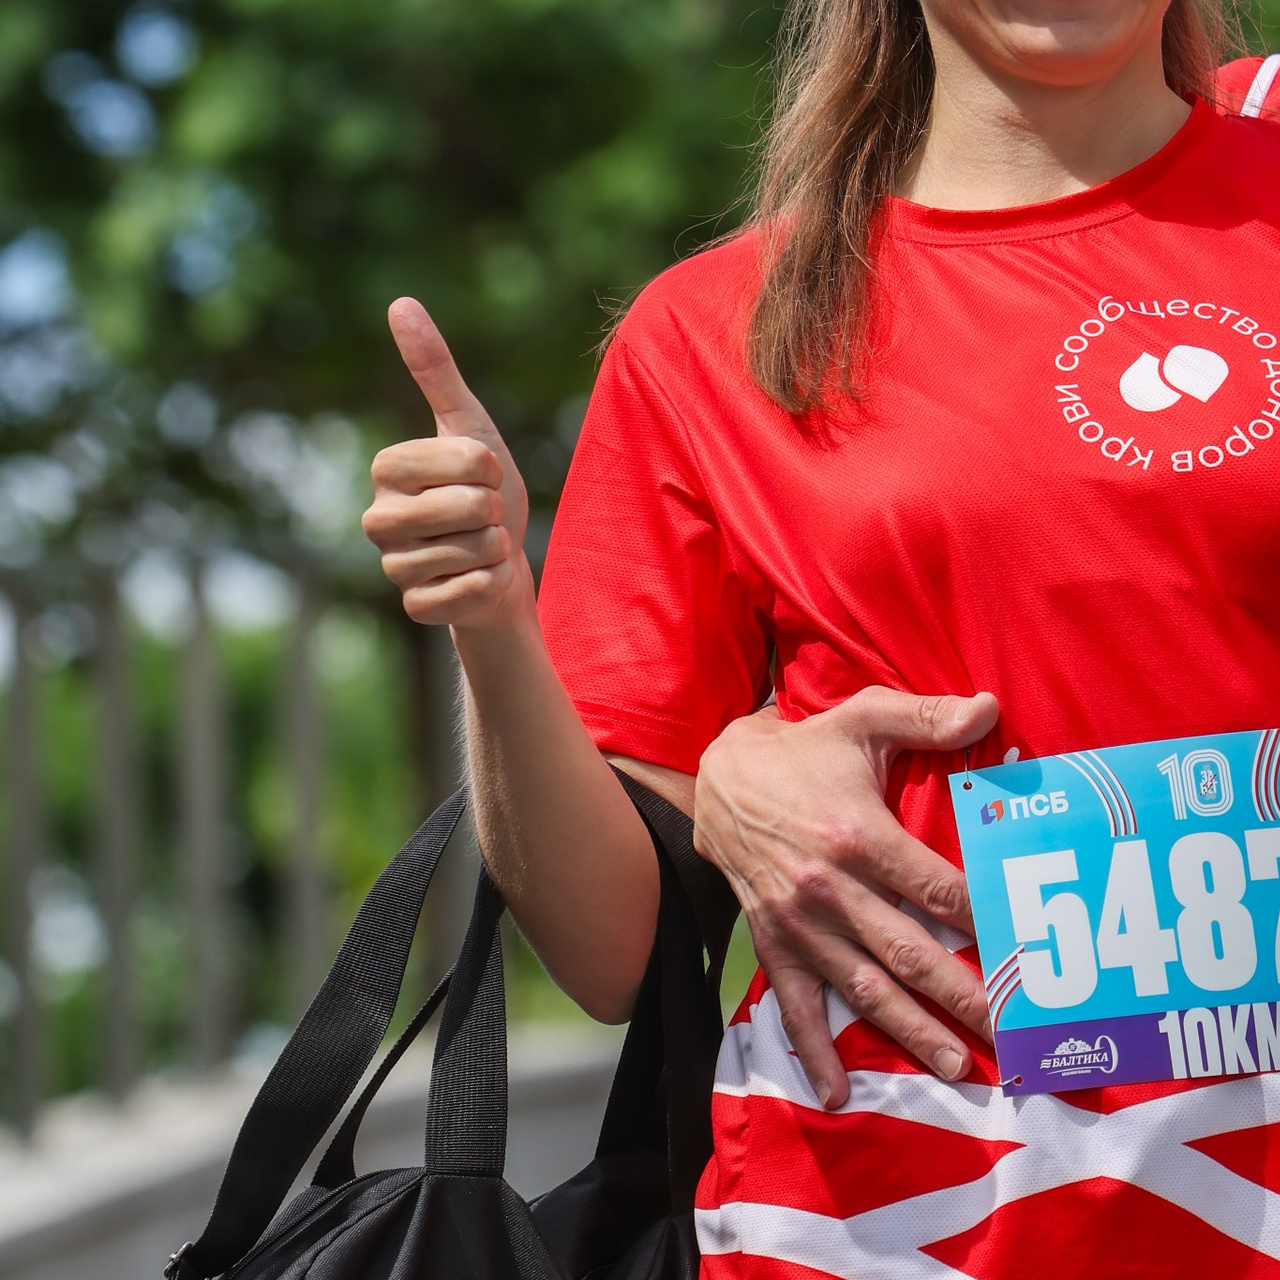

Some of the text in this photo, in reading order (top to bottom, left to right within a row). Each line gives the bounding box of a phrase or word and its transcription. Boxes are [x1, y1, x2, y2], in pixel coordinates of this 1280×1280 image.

[1054, 295, 1278, 372] сообщество
[1054, 383, 1154, 470] крови
[1009, 789, 1070, 820] ПСБ
[1156, 748, 1235, 821] 10
[1051, 1052, 1109, 1068] БАЛТИКА
